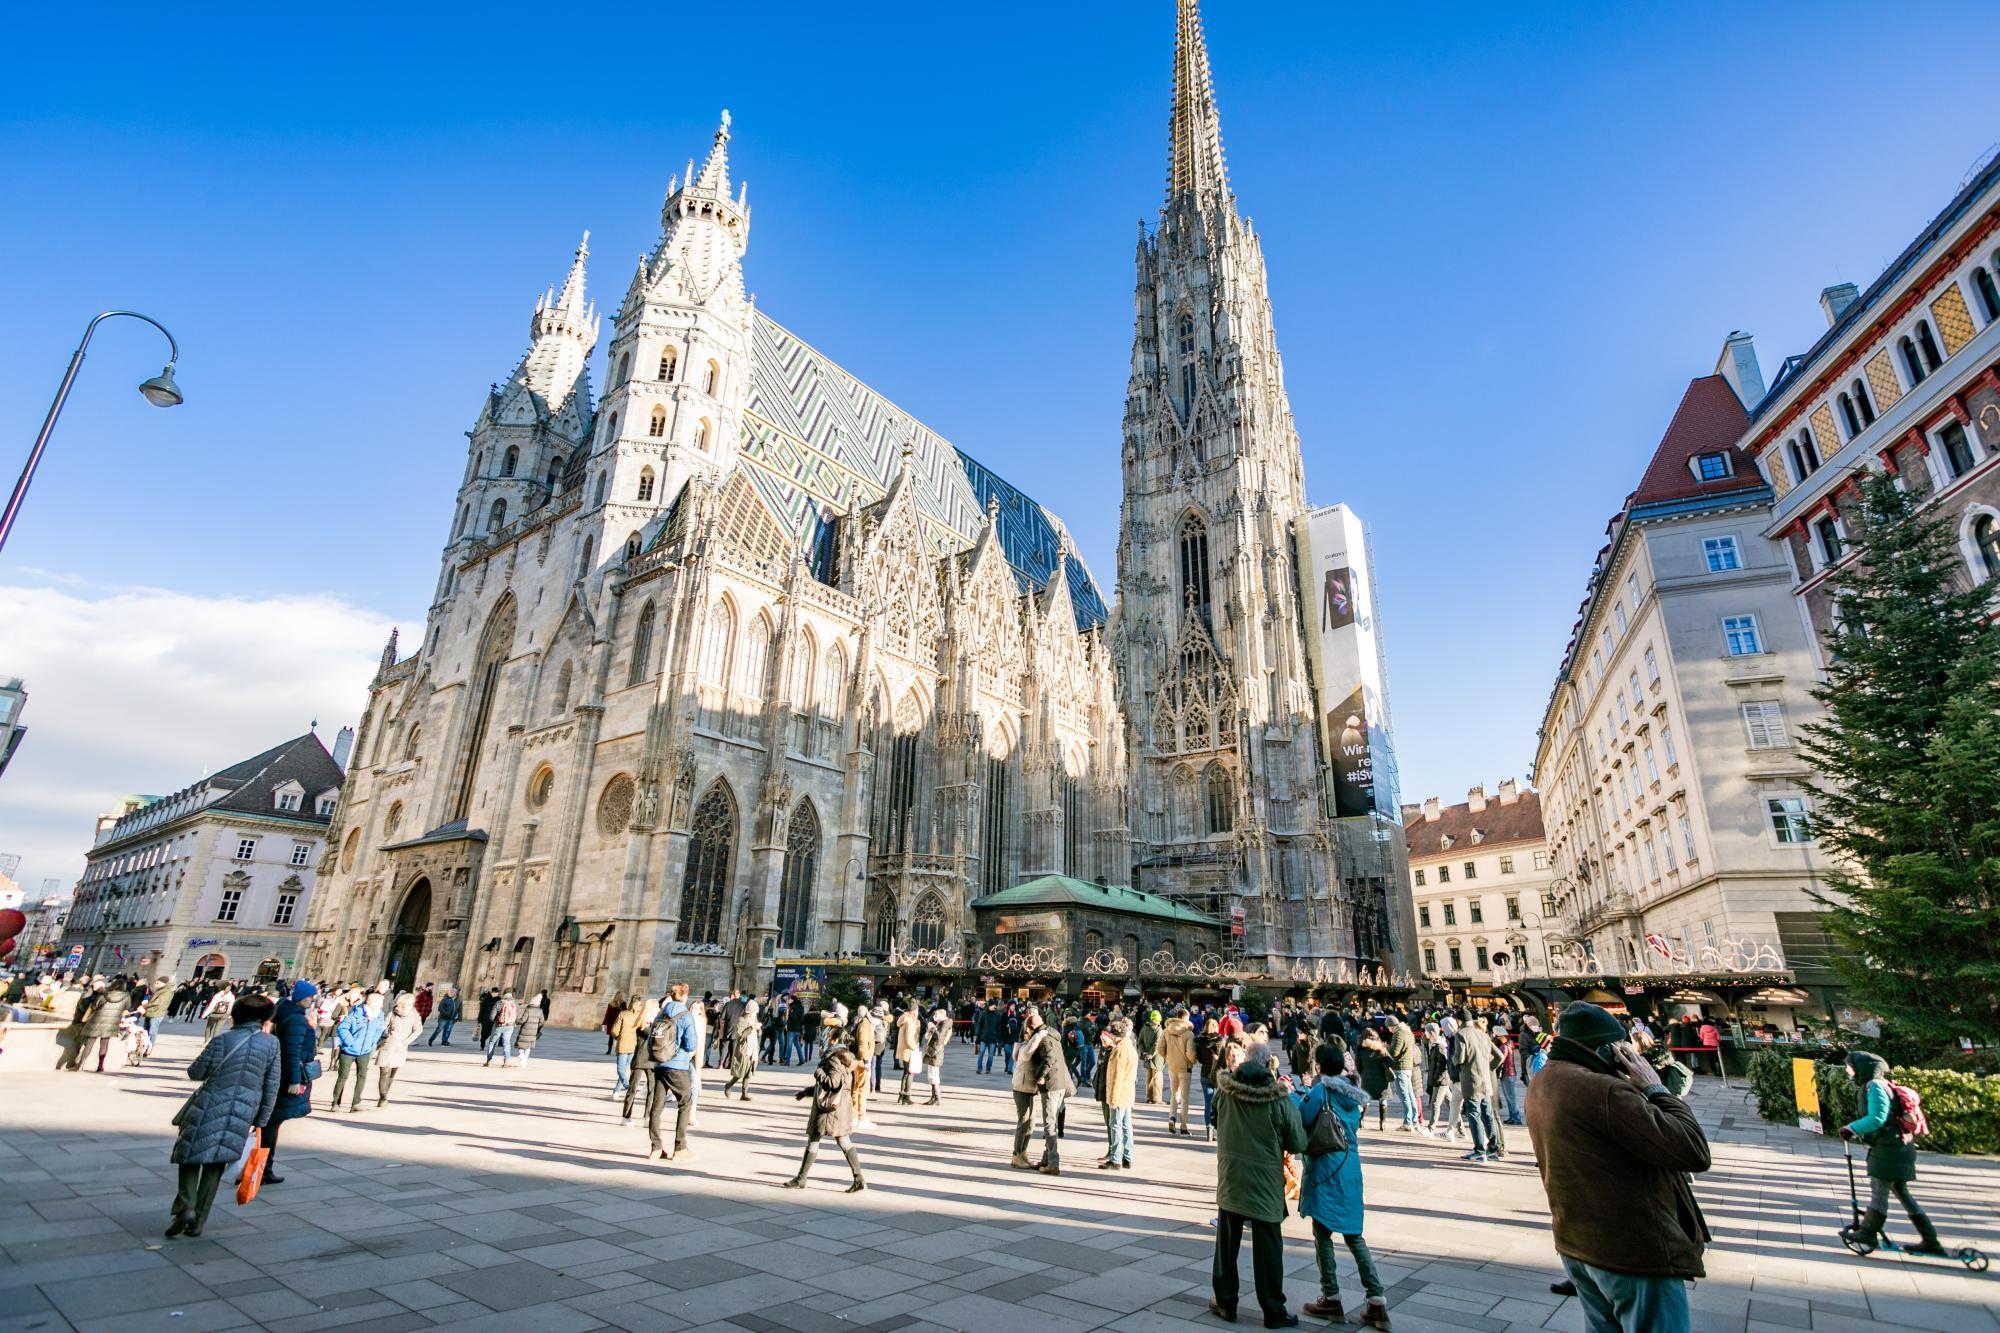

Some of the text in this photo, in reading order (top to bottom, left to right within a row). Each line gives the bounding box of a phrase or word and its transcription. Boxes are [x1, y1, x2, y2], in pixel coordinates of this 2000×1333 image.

[1311, 507, 1340, 519] SAMSUNG
[1325, 551, 1345, 559] Galaxy
[1343, 744, 1364, 756] Wir
